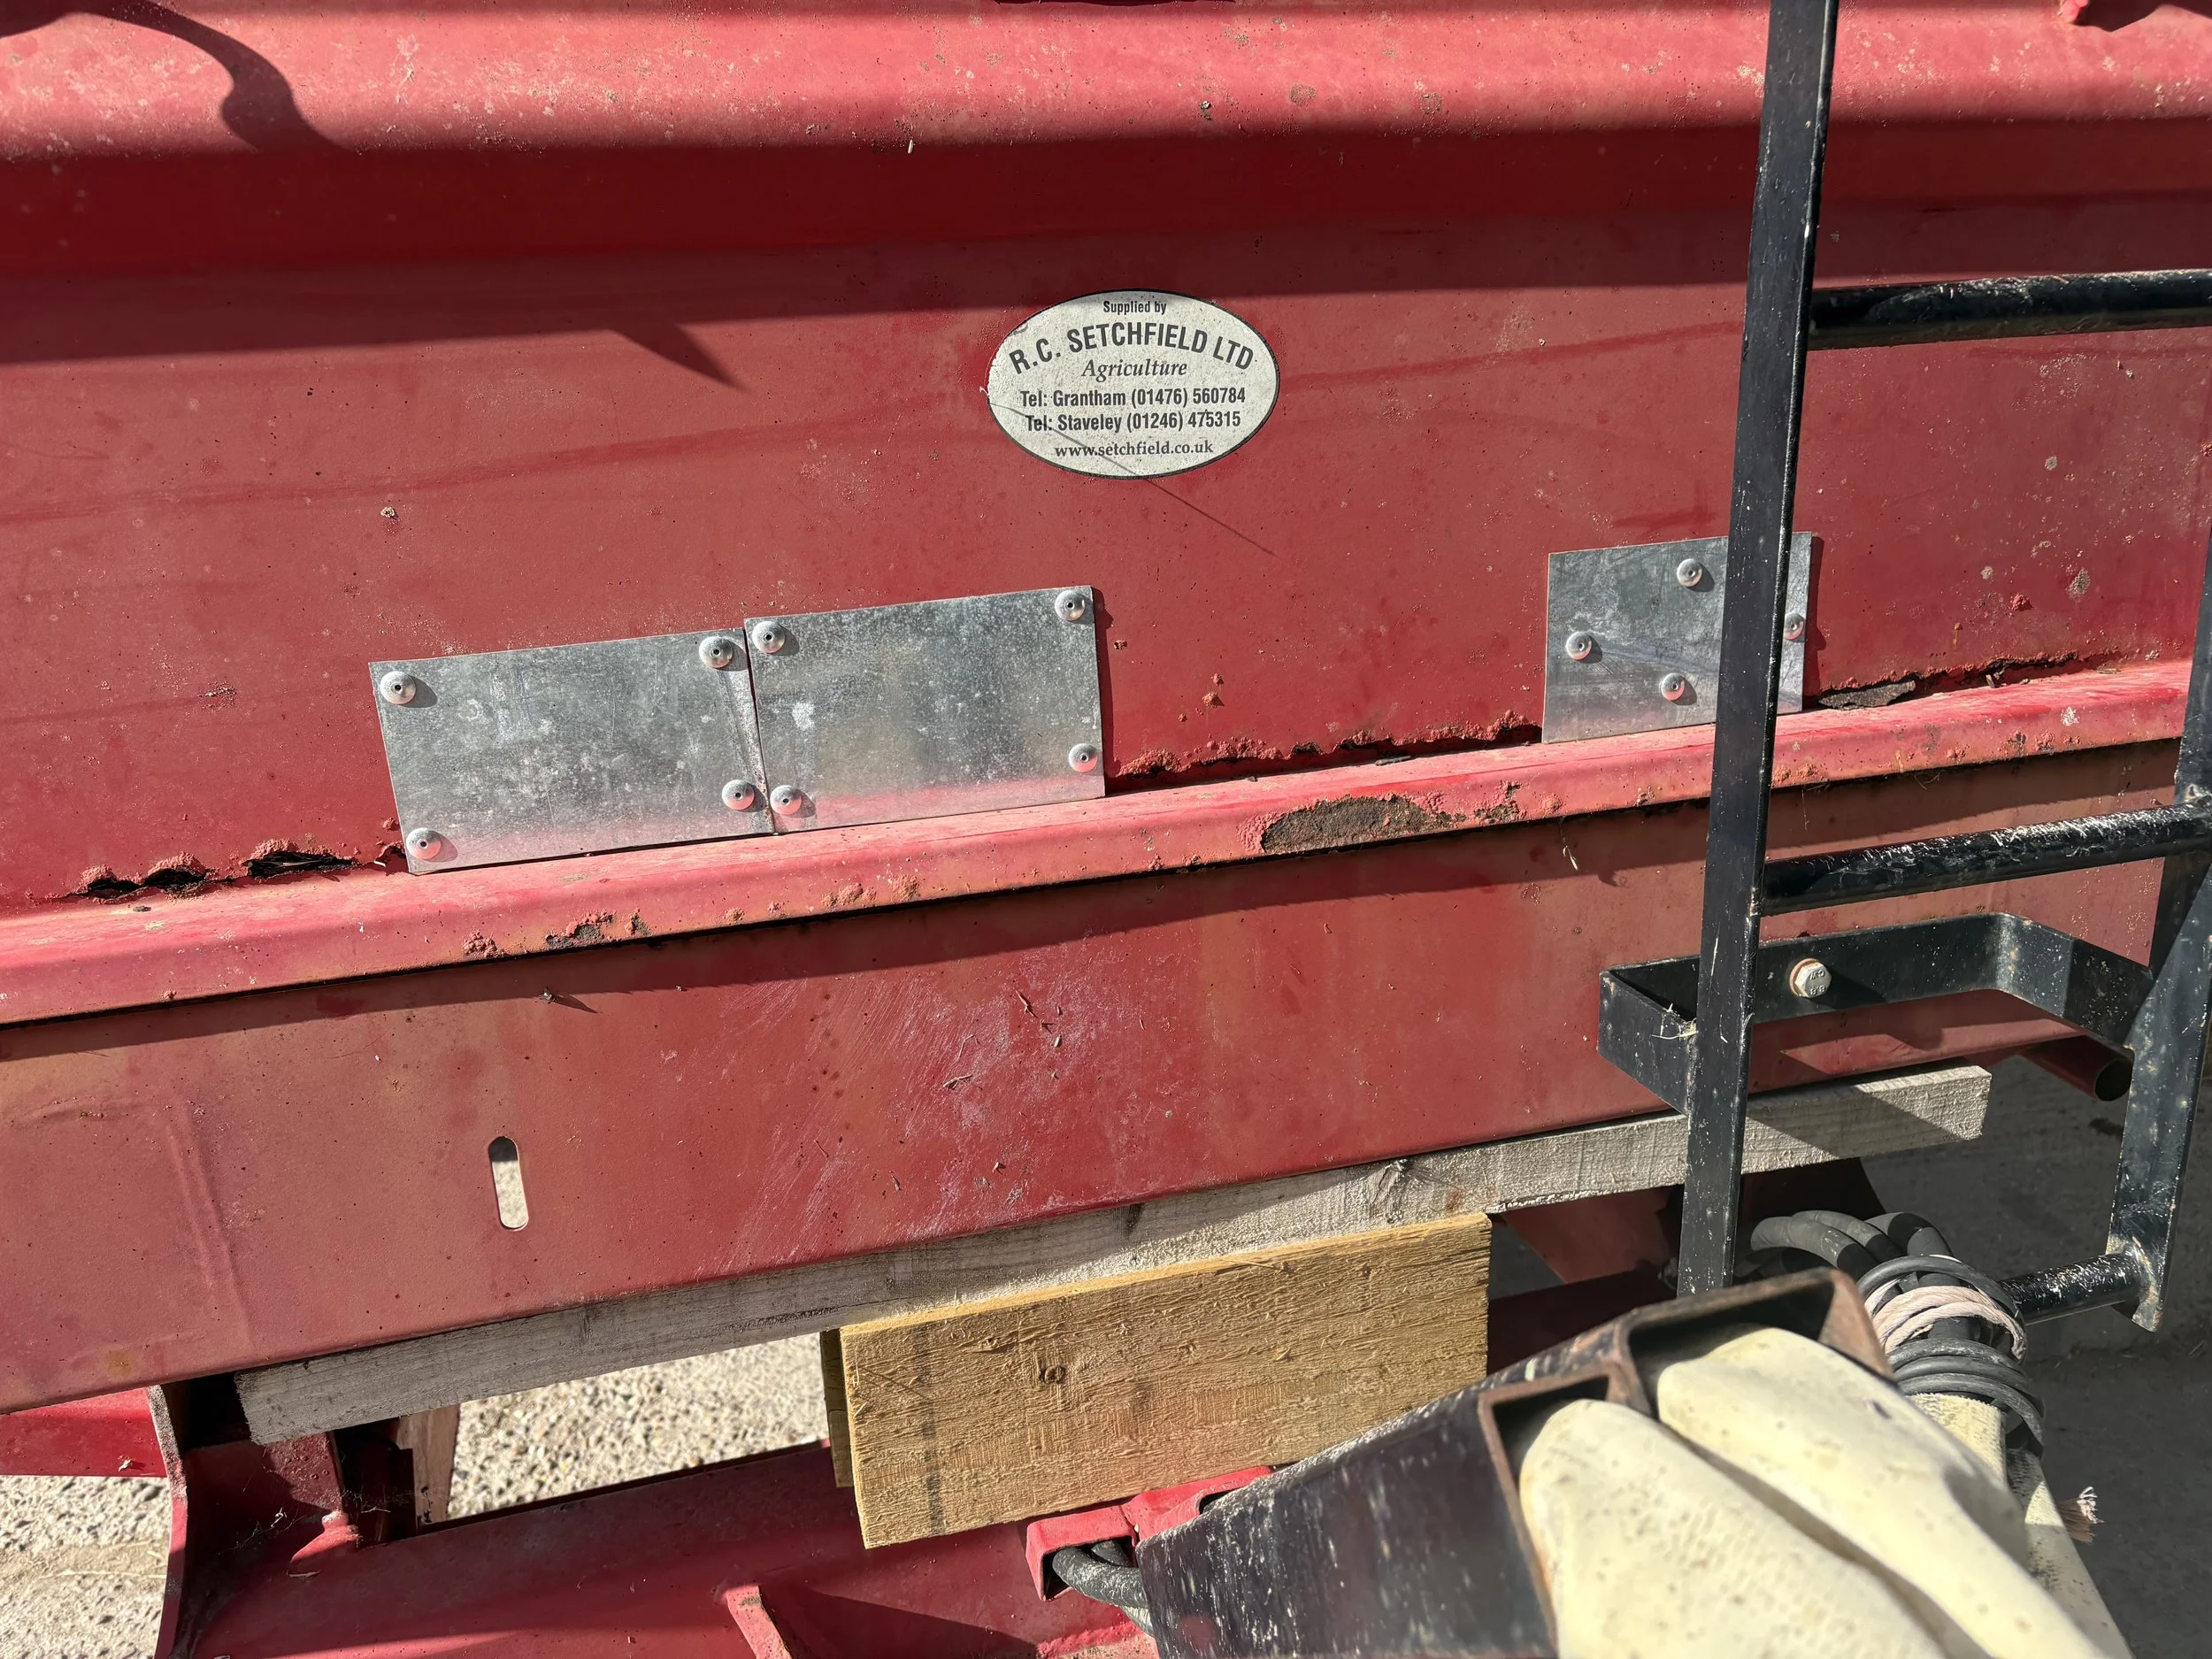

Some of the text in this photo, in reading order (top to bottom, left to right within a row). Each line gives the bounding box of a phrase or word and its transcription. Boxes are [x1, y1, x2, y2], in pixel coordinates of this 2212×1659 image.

[1103, 301, 1166, 315] Supplied by
[1009, 321, 1254, 374] R.C. SETCHFIELD LTD
[1081, 358, 1187, 382] Agriculture
[1020, 388, 1246, 409] Tel: Grantham (01476) 560784
[1025, 411, 1241, 433] Tel: Staveley (01246) 475315
[1055, 440, 1214, 457] www.setchfield.co.uk
